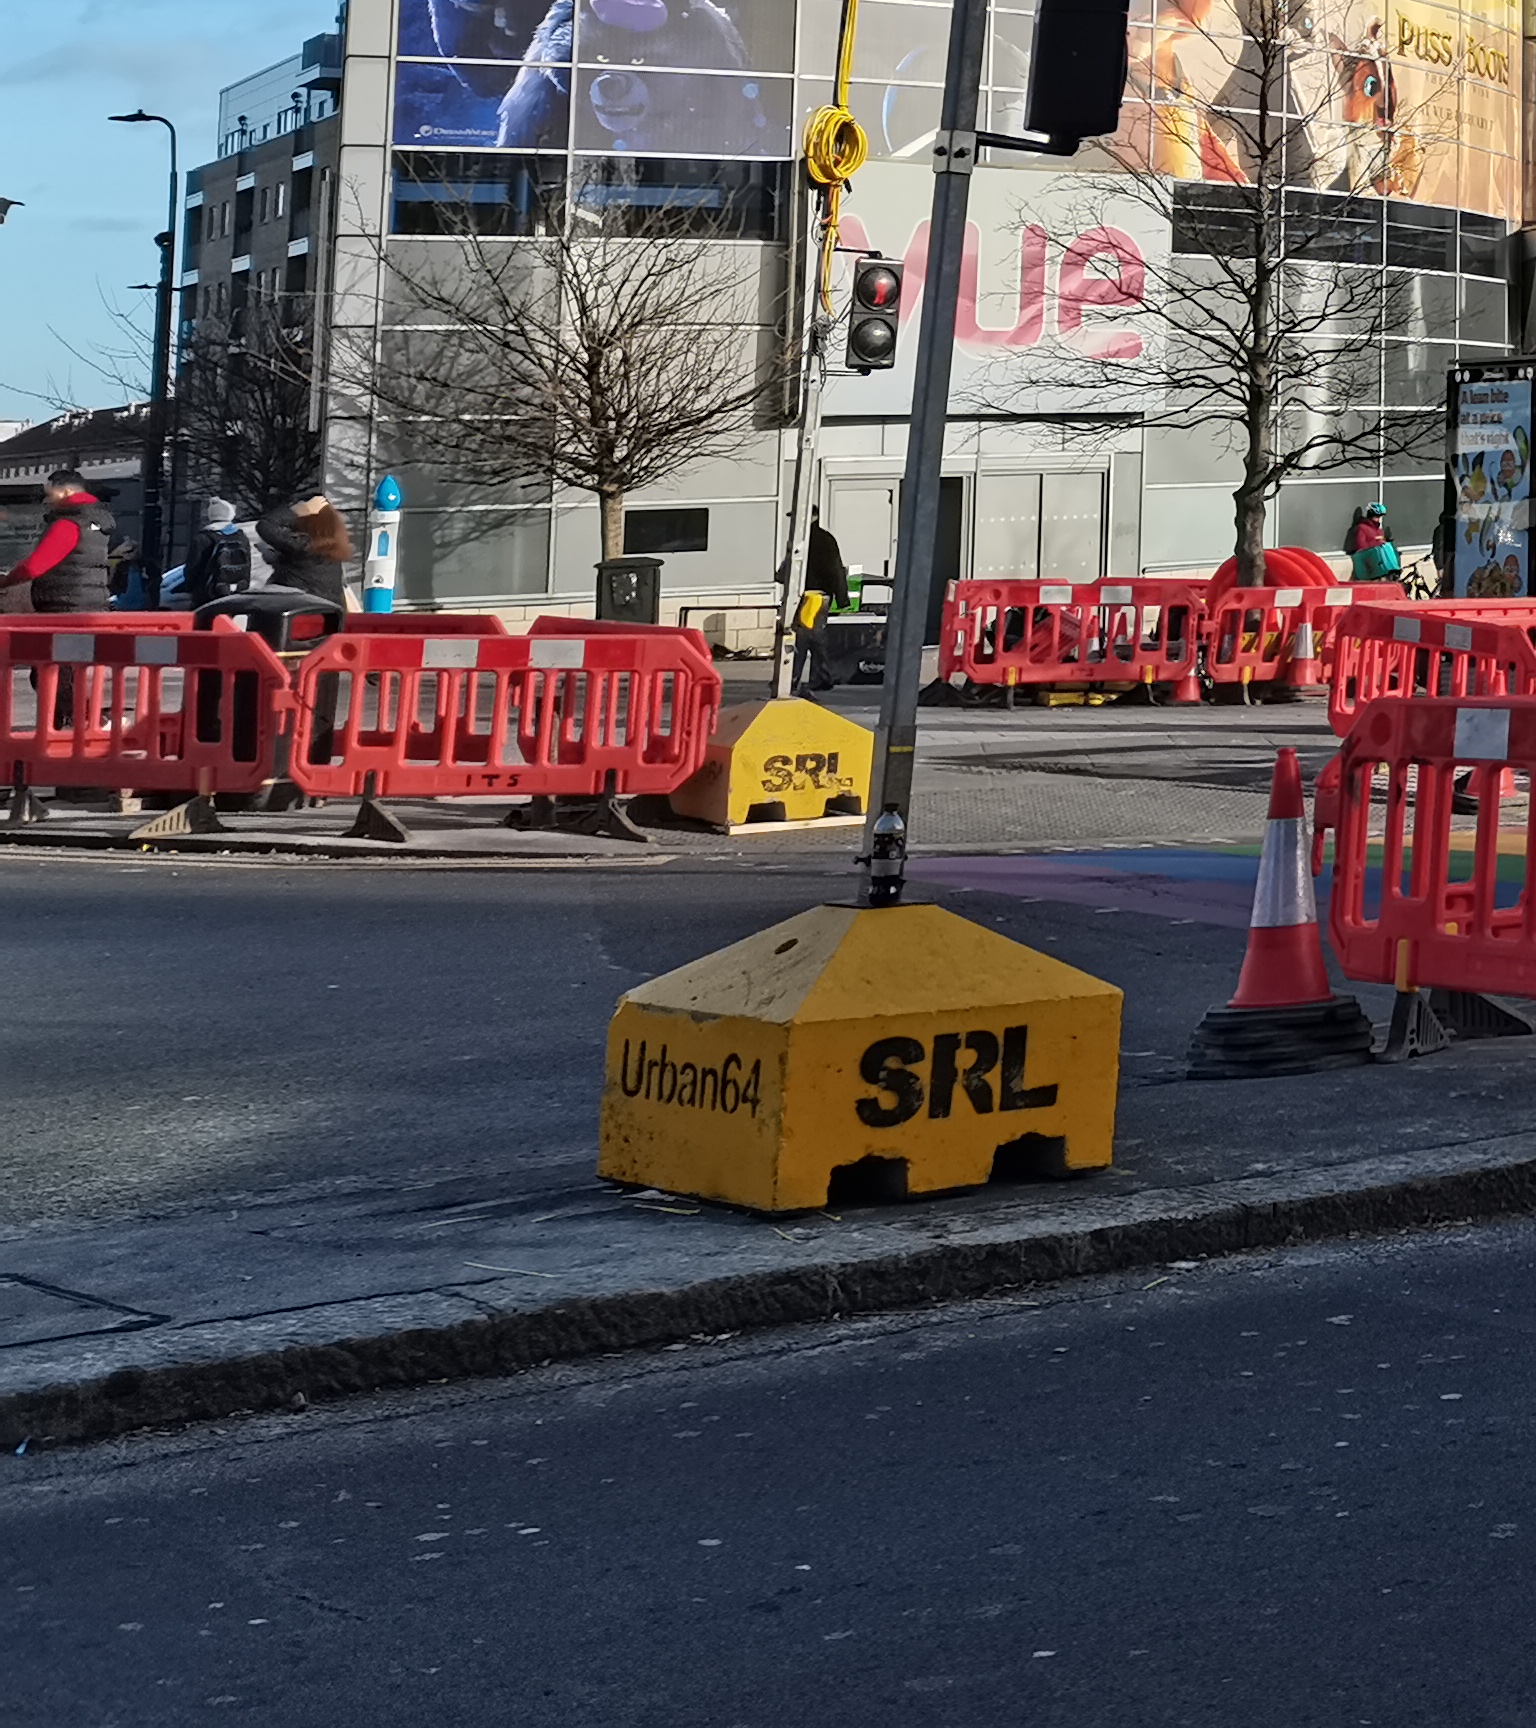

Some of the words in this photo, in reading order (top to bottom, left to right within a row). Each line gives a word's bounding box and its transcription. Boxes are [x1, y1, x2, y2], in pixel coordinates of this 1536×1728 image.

[1396, 8, 1452, 67] PUSS
[761, 752, 853, 793] SRL
[622, 1038, 762, 1119] Urban64
[855, 1024, 1059, 1128] SRL
